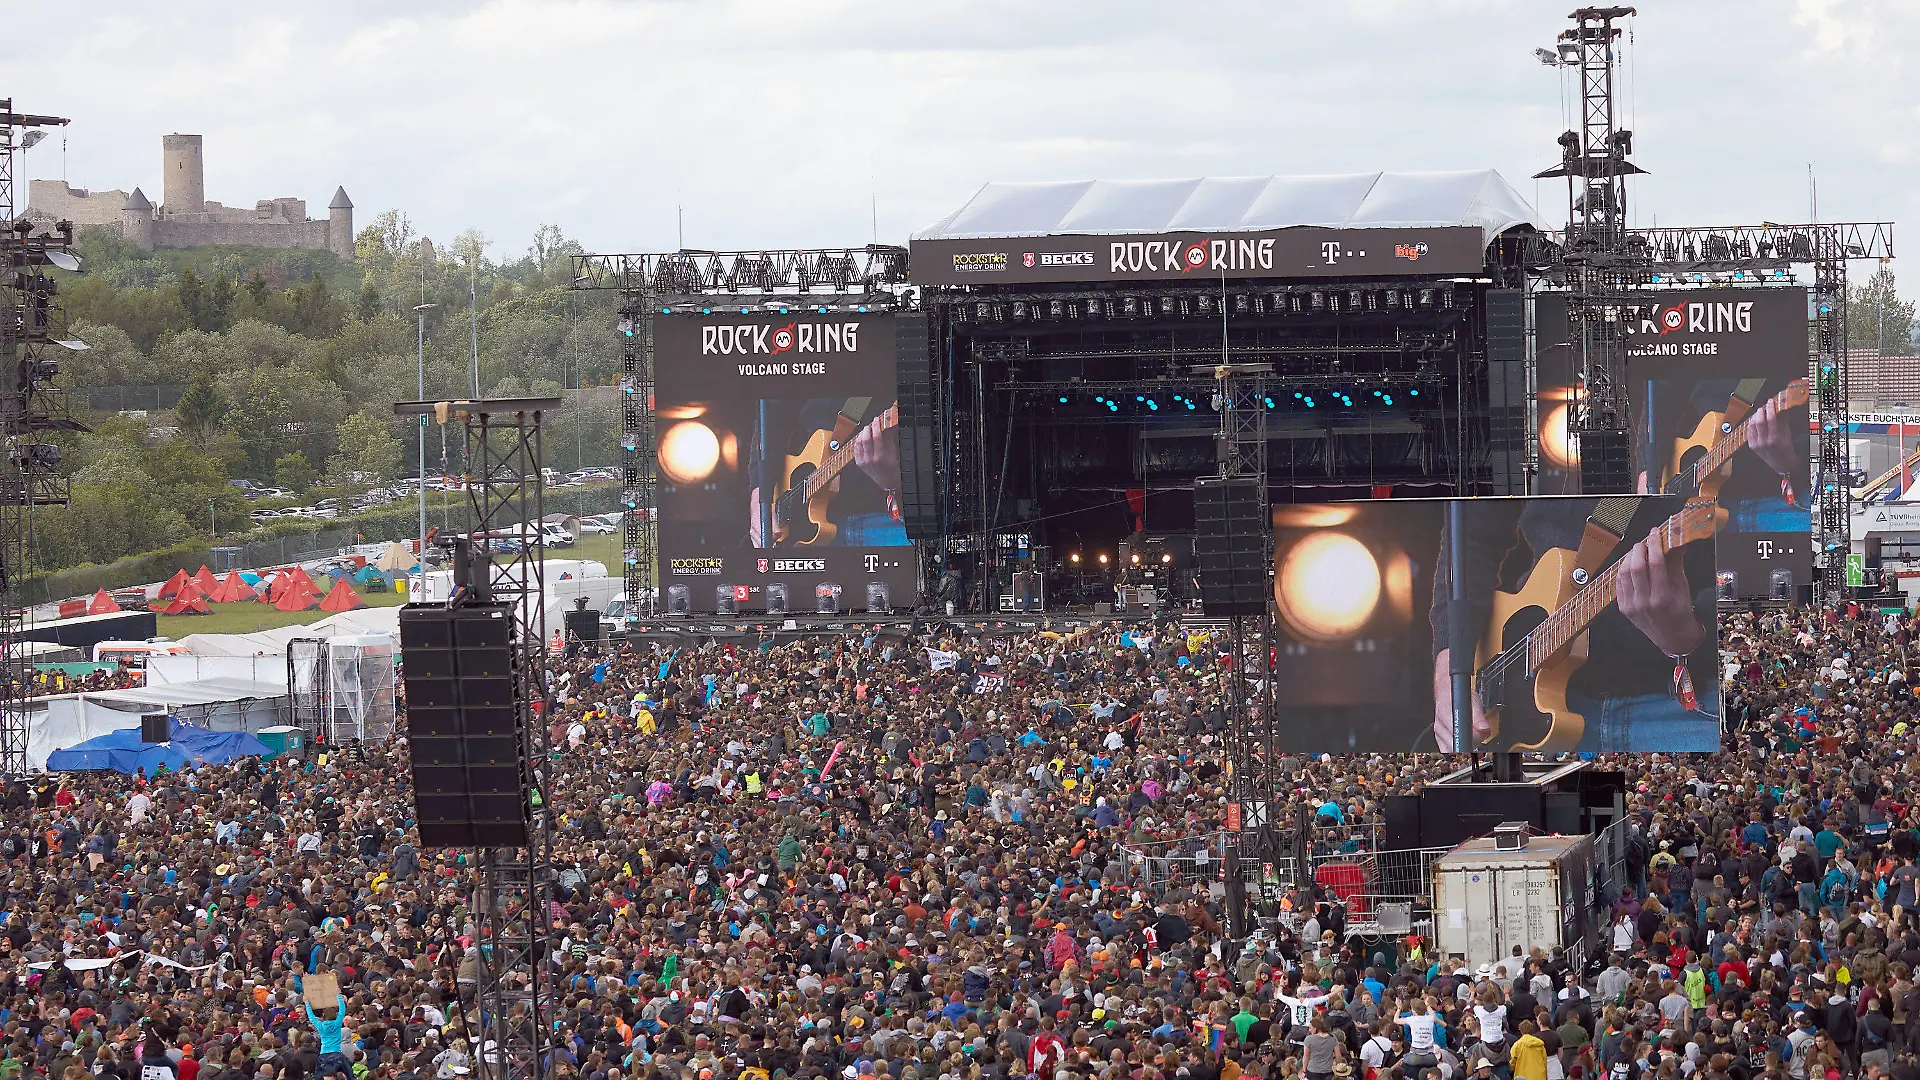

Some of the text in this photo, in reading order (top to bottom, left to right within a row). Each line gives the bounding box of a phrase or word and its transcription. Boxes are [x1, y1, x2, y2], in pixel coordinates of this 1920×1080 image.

[1041, 252, 1094, 265] BECK'S
[1110, 241, 1183, 272] ROCK
[1211, 239, 1276, 271] RING
[984, 263, 1007, 271] DRINK
[1689, 301, 1754, 333] RING
[702, 324, 771, 355] ROCK
[798, 322, 860, 353] RING
[1682, 342, 1718, 355] STAGE
[738, 362, 826, 376] VOLCANO STAGE
[774, 558, 826, 571] BECK'S
